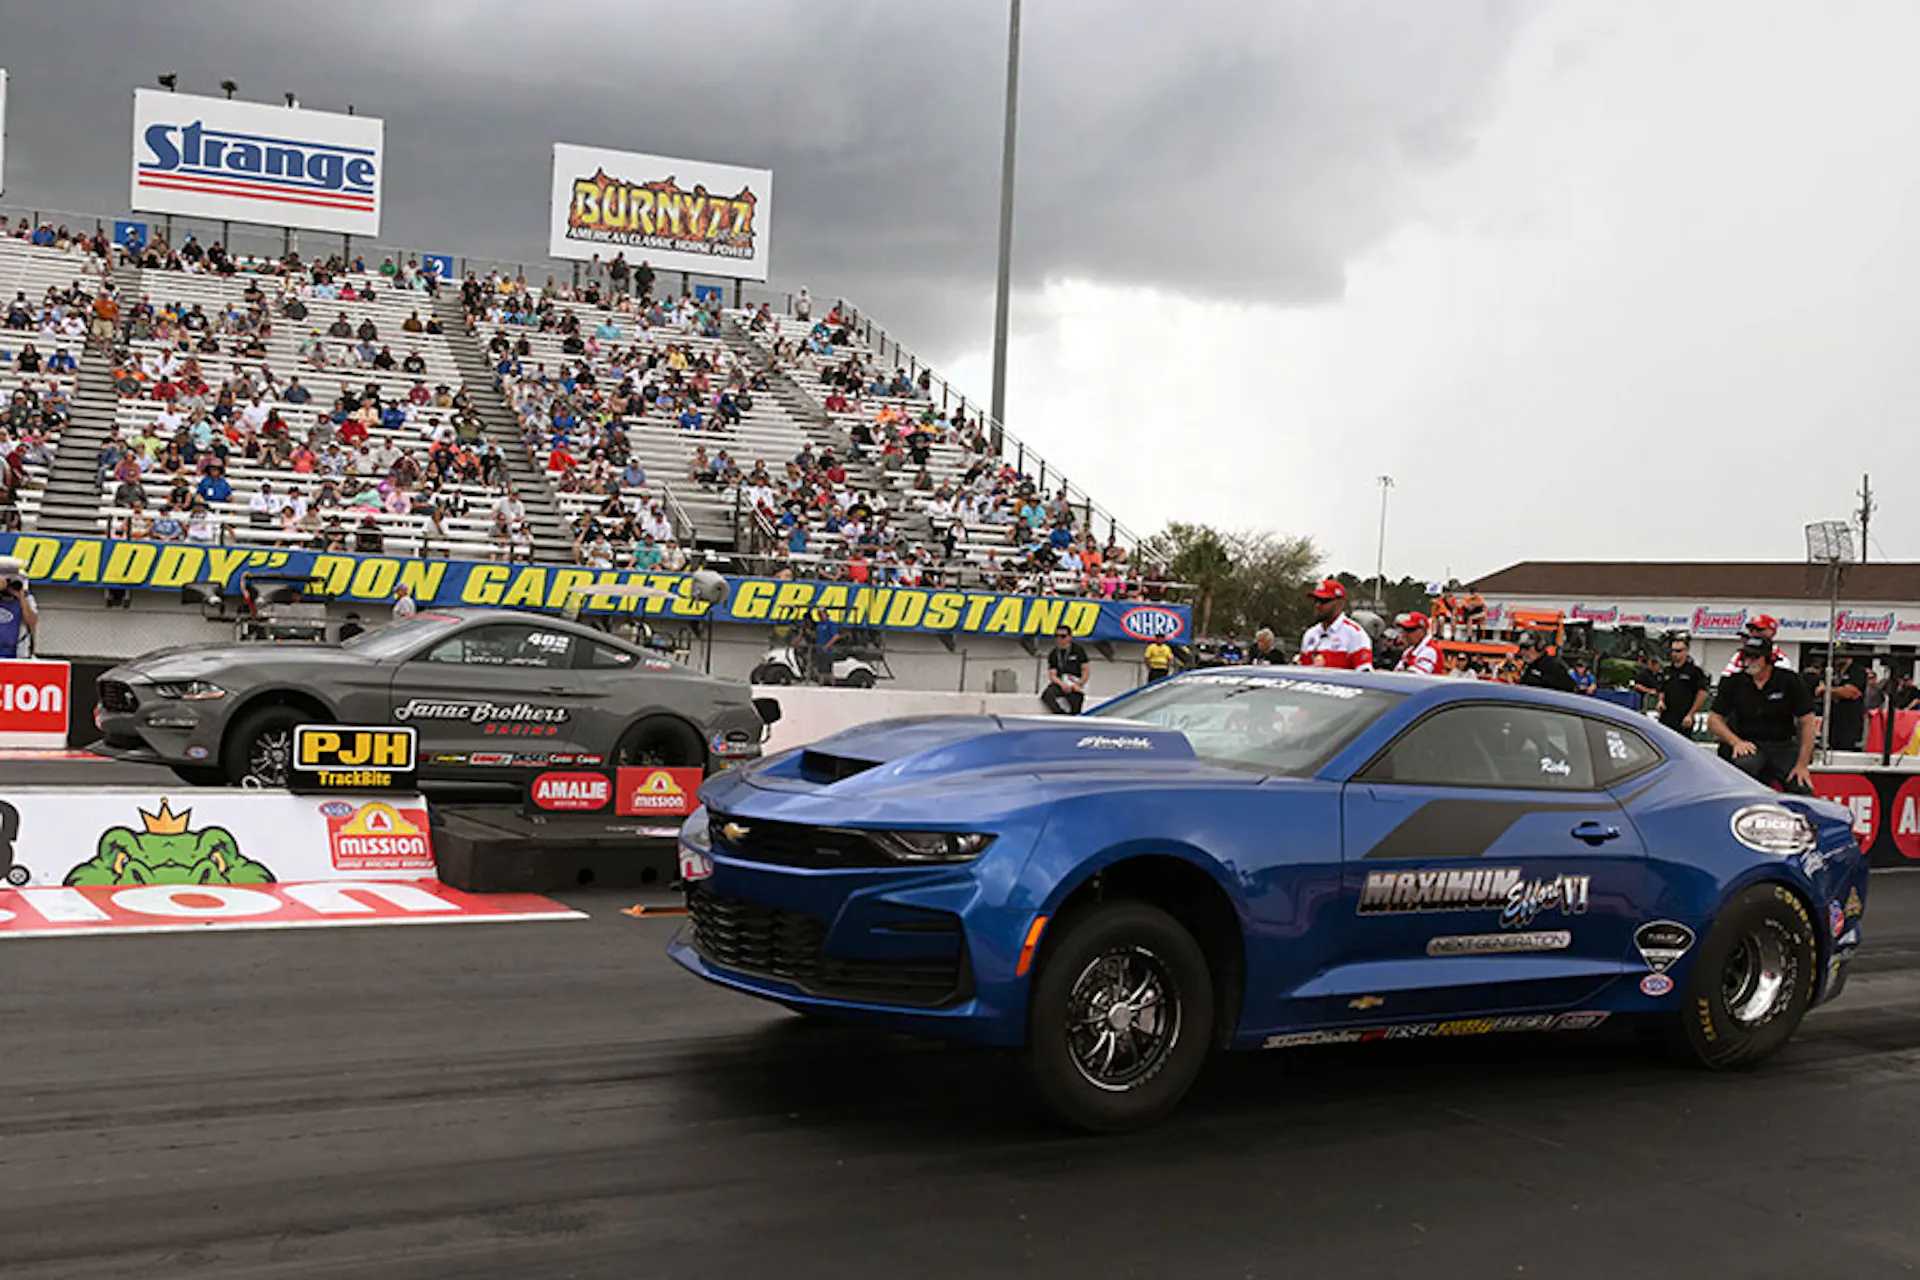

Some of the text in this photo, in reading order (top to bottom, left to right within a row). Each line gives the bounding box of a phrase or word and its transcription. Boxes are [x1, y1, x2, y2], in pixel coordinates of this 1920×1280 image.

[140, 120, 375, 191] Strange
[712, 243, 753, 259] POWER
[304, 555, 447, 601] DON
[731, 580, 1101, 637] GRANDSTAND
[1126, 611, 1178, 636] NHRA
[528, 632, 569, 649] 402
[0, 684, 62, 712] ion
[470, 702, 570, 723] Brothers
[484, 723, 558, 735] RACING
[302, 731, 408, 765] PJH
[317, 770, 391, 787] TrackBite
[537, 781, 607, 800] AMALIE
[1359, 868, 1590, 926] MAXIMUM Effort VI
[1475, 934, 1566, 950] GENERATION
